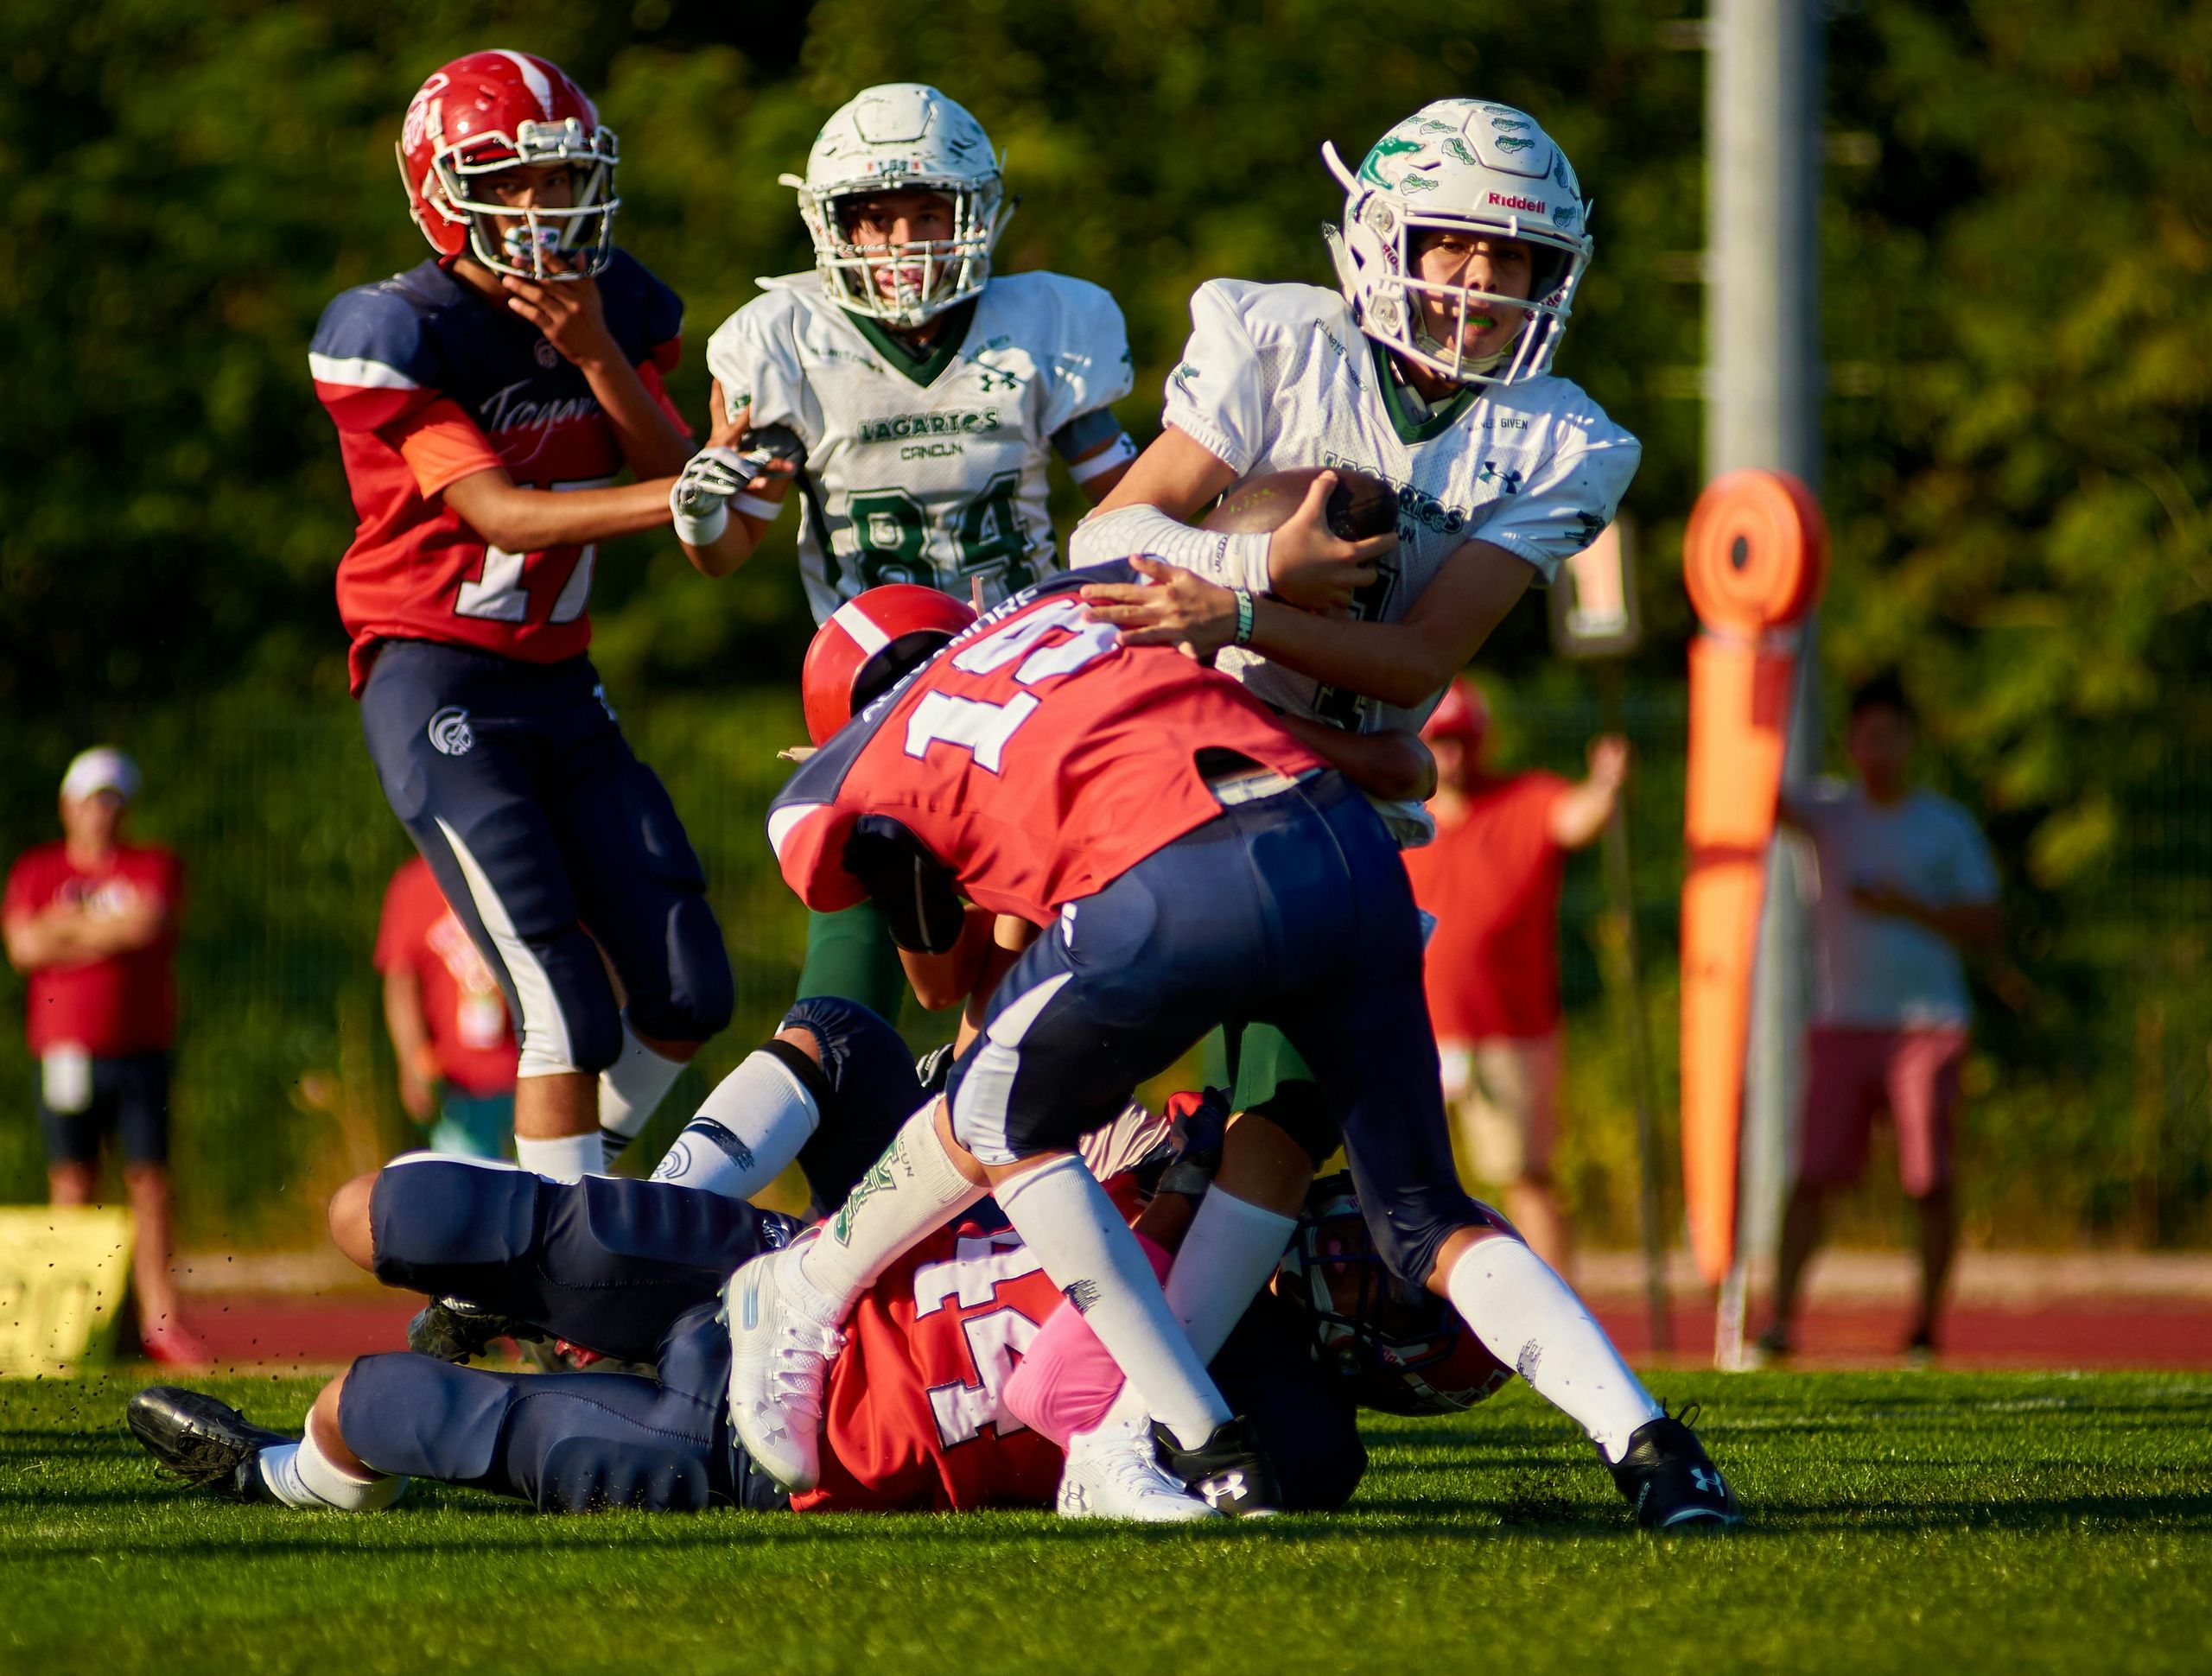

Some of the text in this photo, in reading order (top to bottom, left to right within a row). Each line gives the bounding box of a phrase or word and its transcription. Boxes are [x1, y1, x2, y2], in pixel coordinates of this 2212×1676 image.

[1488, 192, 1546, 214] Riddell
[1500, 417, 1529, 430] GIVEN
[844, 469, 1037, 596] 84
